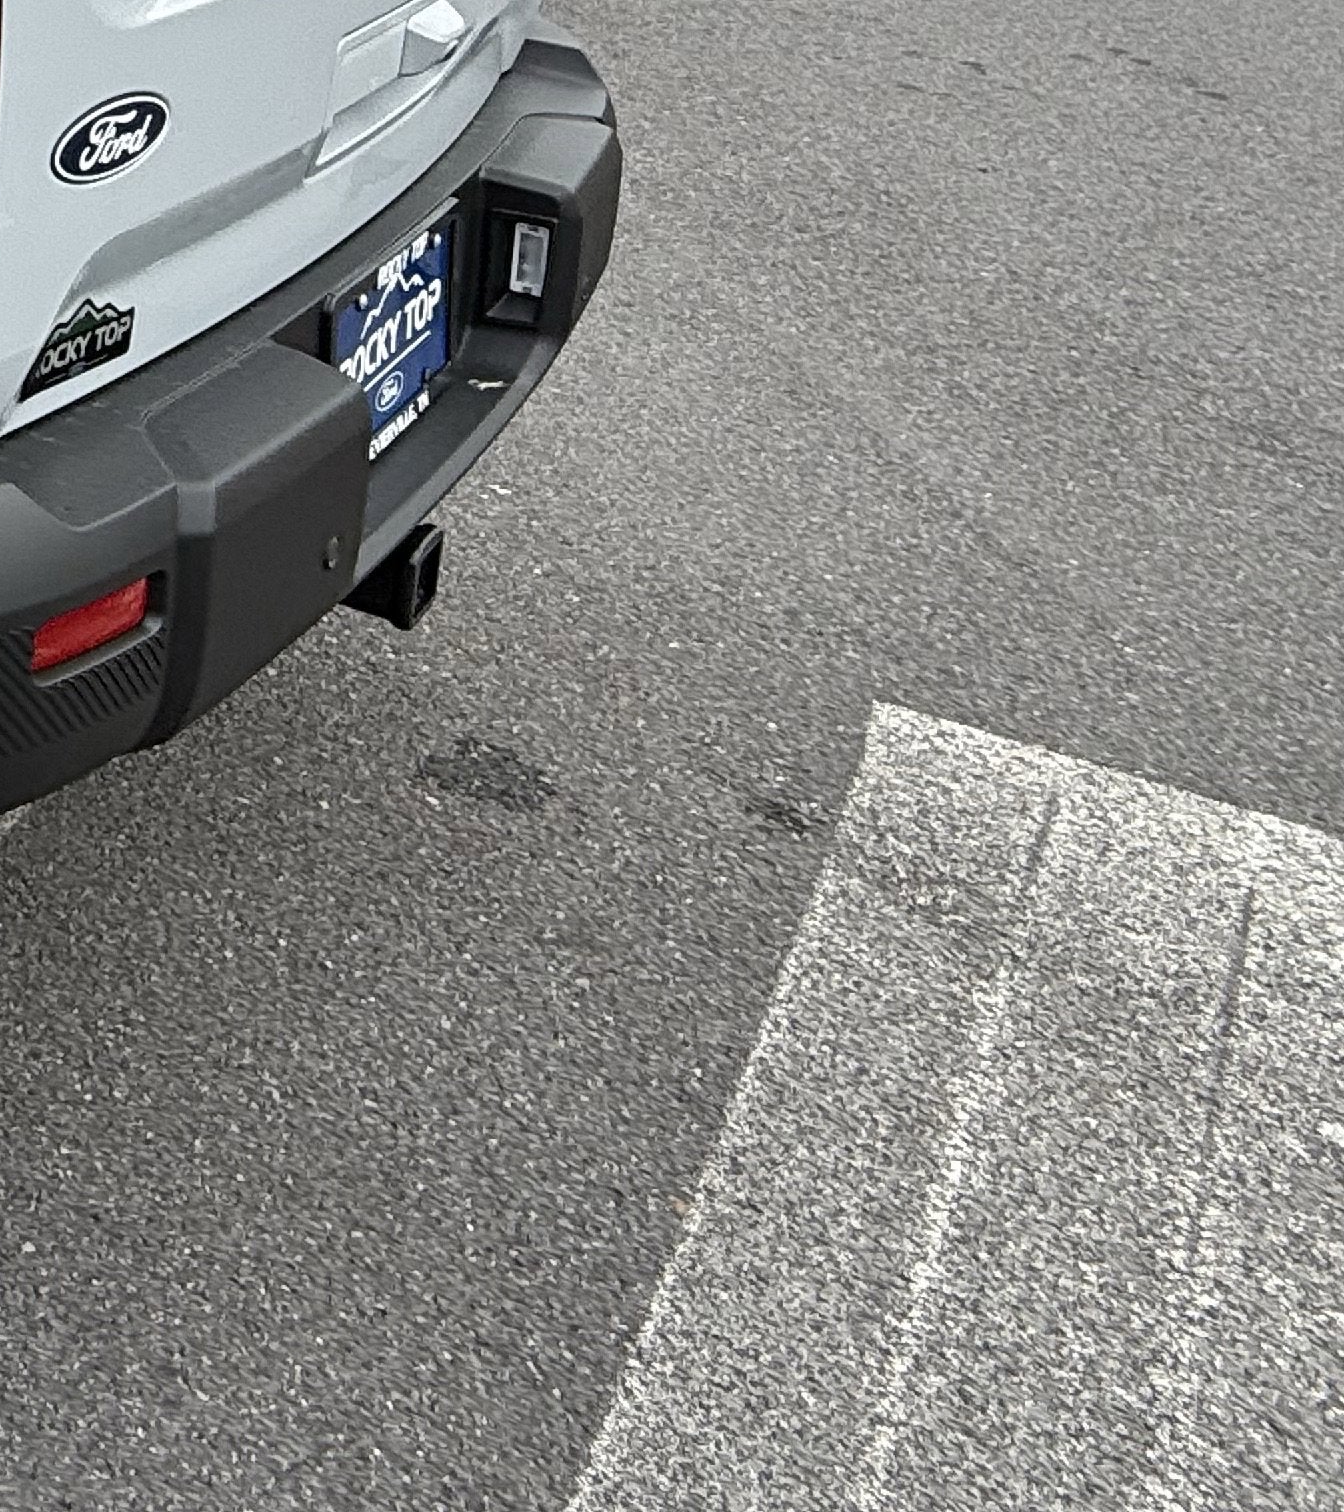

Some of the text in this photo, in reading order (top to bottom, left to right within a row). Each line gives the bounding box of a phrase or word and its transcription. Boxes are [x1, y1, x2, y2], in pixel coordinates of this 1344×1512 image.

[78, 109, 153, 172] Ford
[404, 278, 442, 340] TOP
[34, 315, 132, 378] OCKY TOP
